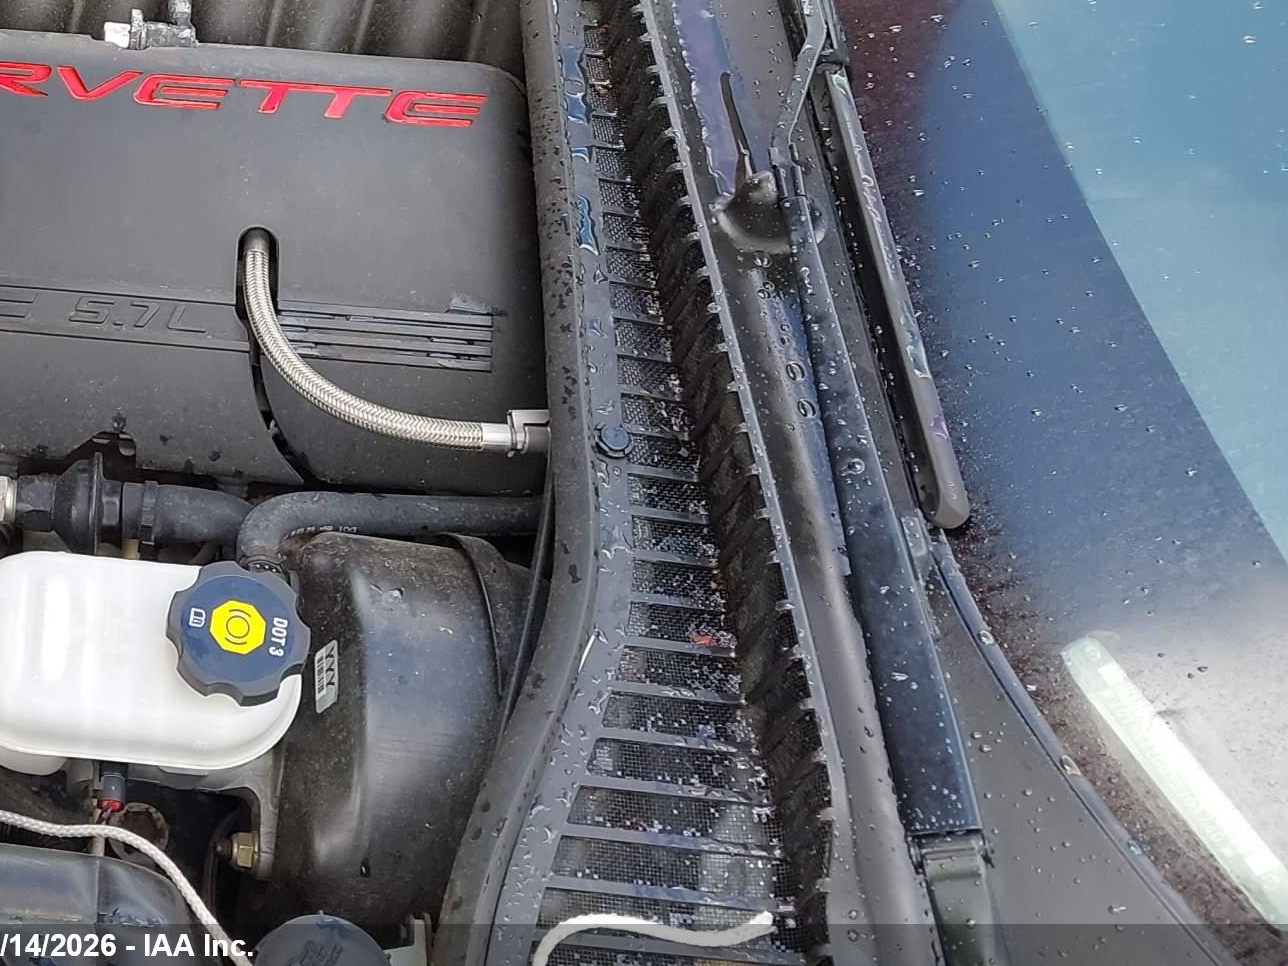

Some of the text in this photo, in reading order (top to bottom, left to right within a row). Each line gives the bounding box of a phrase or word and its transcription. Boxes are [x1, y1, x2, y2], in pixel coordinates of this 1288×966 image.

[68, 296, 207, 334] 5.7L
[269, 617, 288, 658] DOT 3
